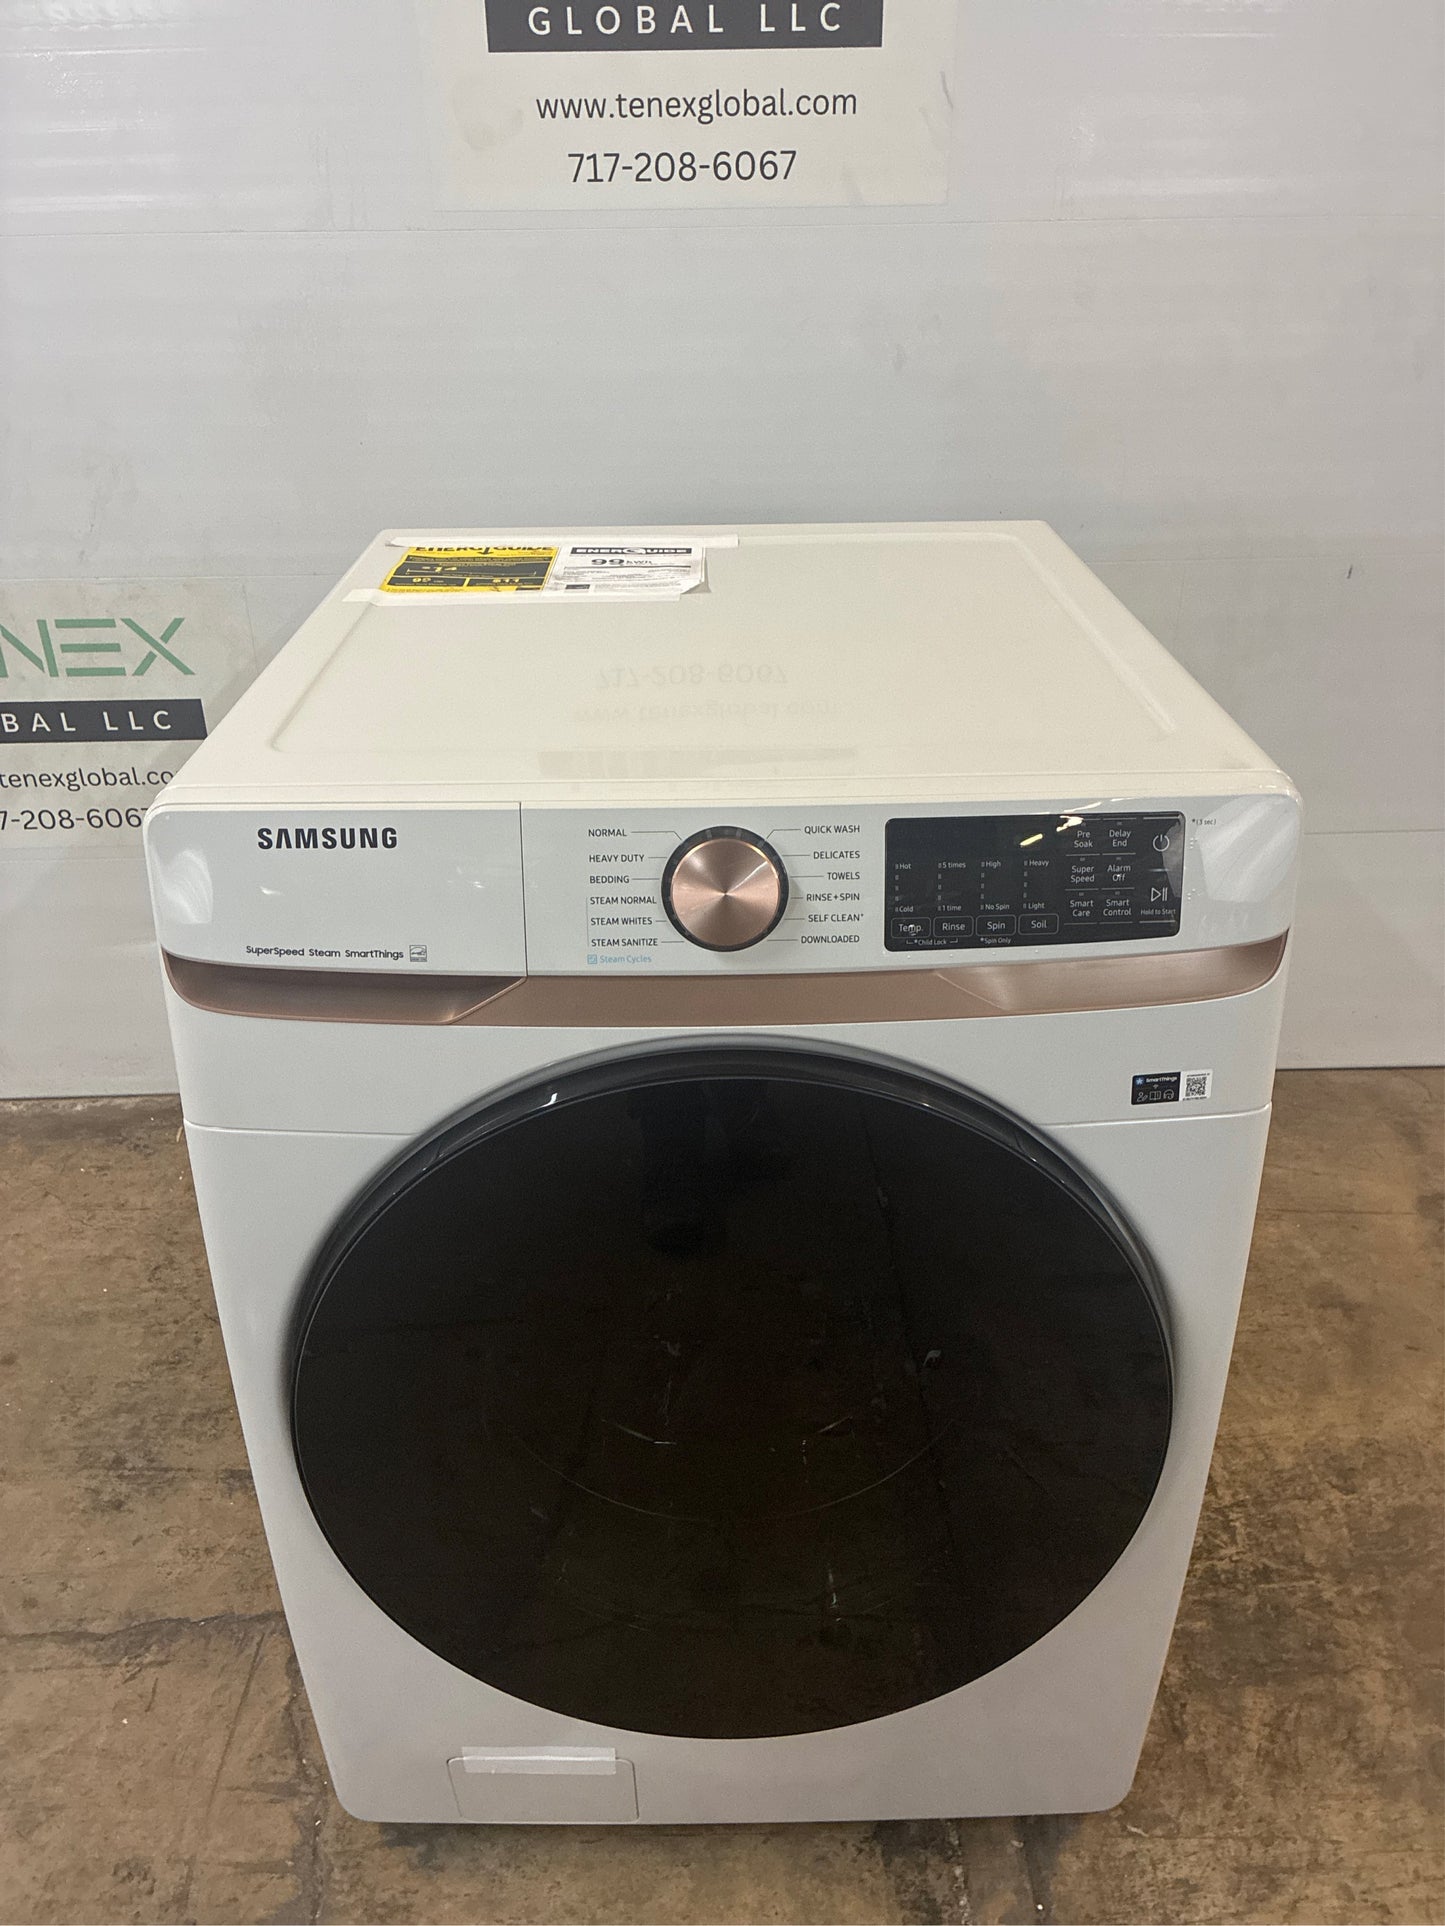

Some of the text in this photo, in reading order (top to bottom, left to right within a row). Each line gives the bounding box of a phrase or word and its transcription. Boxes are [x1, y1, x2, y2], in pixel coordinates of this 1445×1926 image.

[528, 3, 841, 36] GLOBAL LLC
[536, 88, 857, 125] www.tenexglobal.com
[567, 150, 798, 183] 717-208-6067
[1, 710, 172, 733] BAL LLC
[0, 766, 177, 792] tenexglobal.co
[0, 807, 148, 830] 7-208-606
[588, 828, 627, 837] NORMAL
[804, 825, 860, 834] QUICK WASH
[1077, 830, 1091, 838] Pre
[1109, 829, 1131, 839] Delay
[257, 827, 398, 850] SAMSUNG
[1112, 838, 1127, 847] End
[1074, 839, 1093, 848] Soak
[589, 854, 645, 863] HEAVY DUTY
[813, 850, 860, 859] DELICATES
[899, 862, 911, 870] Hot
[948, 861, 966, 869] times
[985, 860, 1001, 868] High
[1029, 859, 1049, 867] Heavy
[1107, 863, 1131, 872] Alarm
[1071, 865, 1095, 875] Super
[589, 875, 630, 884] BEDDING
[827, 871, 860, 880] TOWELS
[1070, 874, 1095, 883] Speed
[1112, 872, 1126, 882] Off
[590, 896, 657, 905] STEAM NORMAL
[1069, 899, 1094, 908] Smart
[1105, 898, 1129, 907] Smart
[899, 905, 914, 913] Cold
[996, 903, 1010, 911] Spin
[1028, 902, 1045, 910] Light
[1072, 908, 1091, 917] Care
[1103, 907, 1132, 916] Control
[590, 917, 653, 926] STEAM WHITES
[808, 914, 829, 922] SELF
[942, 922, 966, 931] Rinse
[987, 921, 1006, 932] Spin
[1031, 919, 1048, 929] Soil
[591, 938, 658, 947] STEAM SANITIZE
[801, 934, 860, 944] DOWNLOADED
[998, 937, 1011, 945] Only
[246, 945, 305, 957] SuperSpeed
[308, 948, 341, 958] Steam
[345, 949, 404, 961] SmartThings
[600, 954, 652, 964] Steam Cycles
